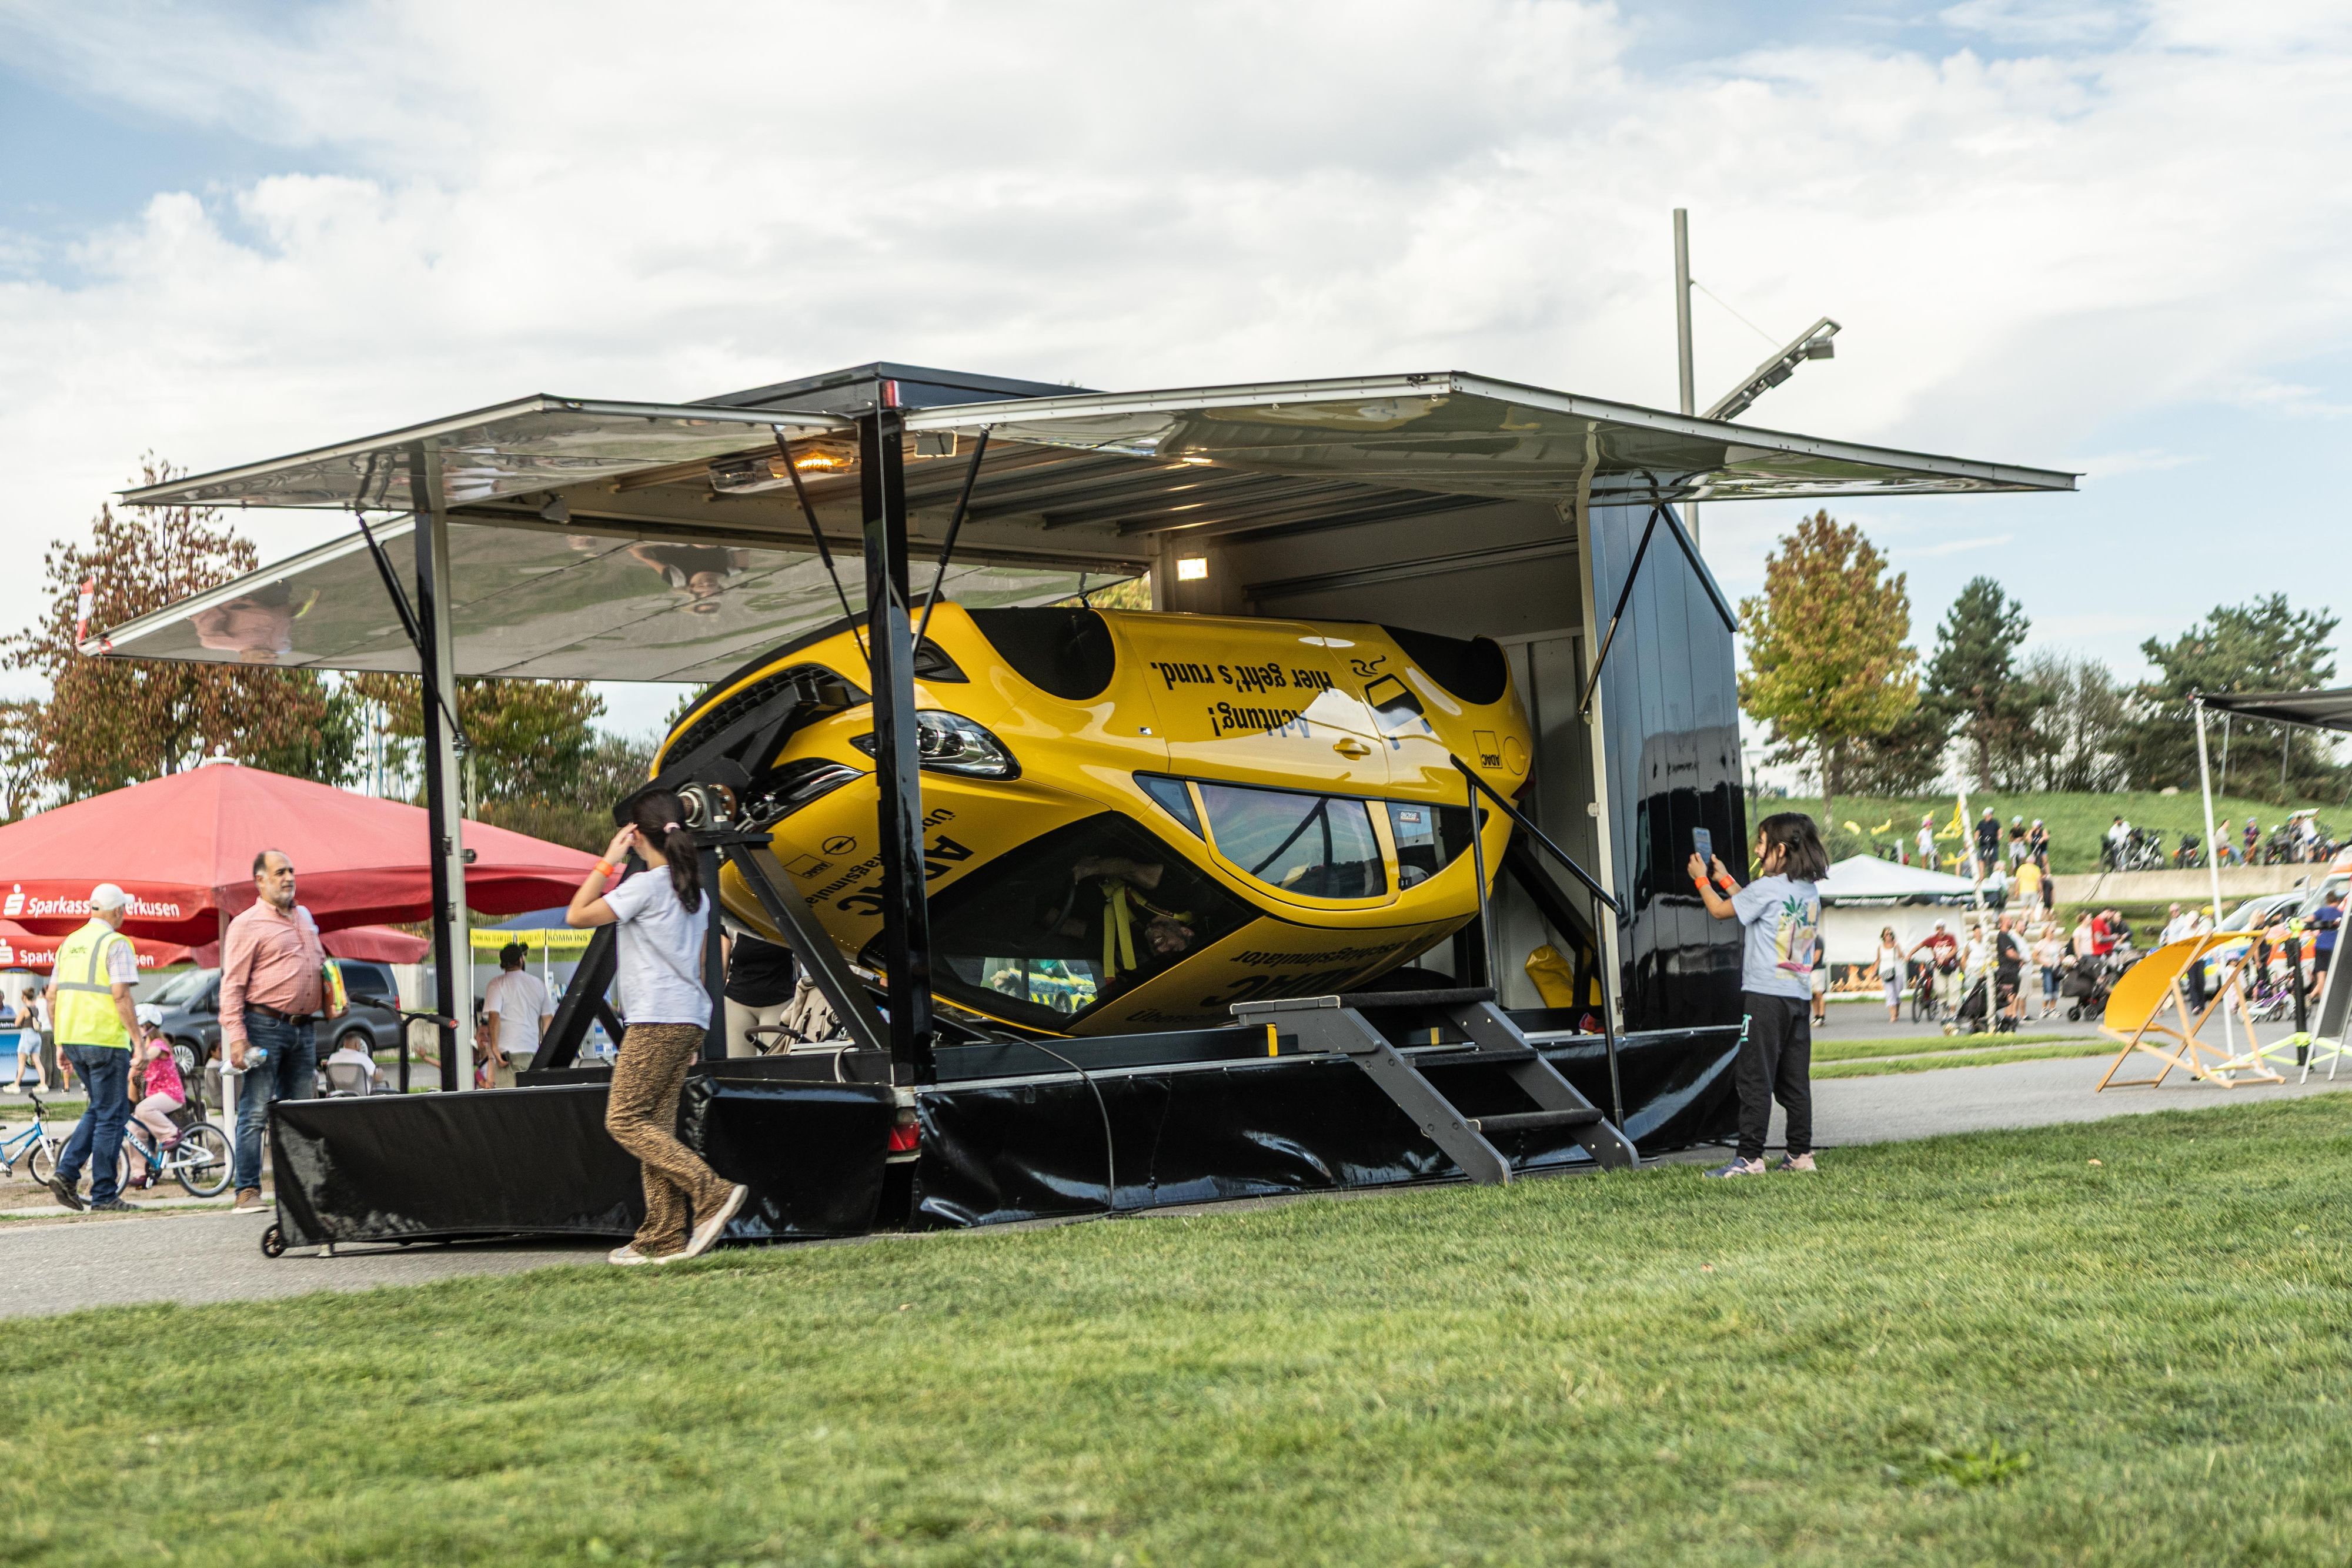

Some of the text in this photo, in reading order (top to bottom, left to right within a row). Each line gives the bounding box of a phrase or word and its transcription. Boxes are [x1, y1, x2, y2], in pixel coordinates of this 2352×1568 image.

[1150, 661, 1338, 697] Hier geht's rund.
[1208, 702, 1311, 738] Achtung!
[1481, 754, 1500, 766] ADAC
[803, 861, 827, 878] ADAC
[27, 895, 91, 918] Sparkass
[19, 949, 55, 967] Spark
